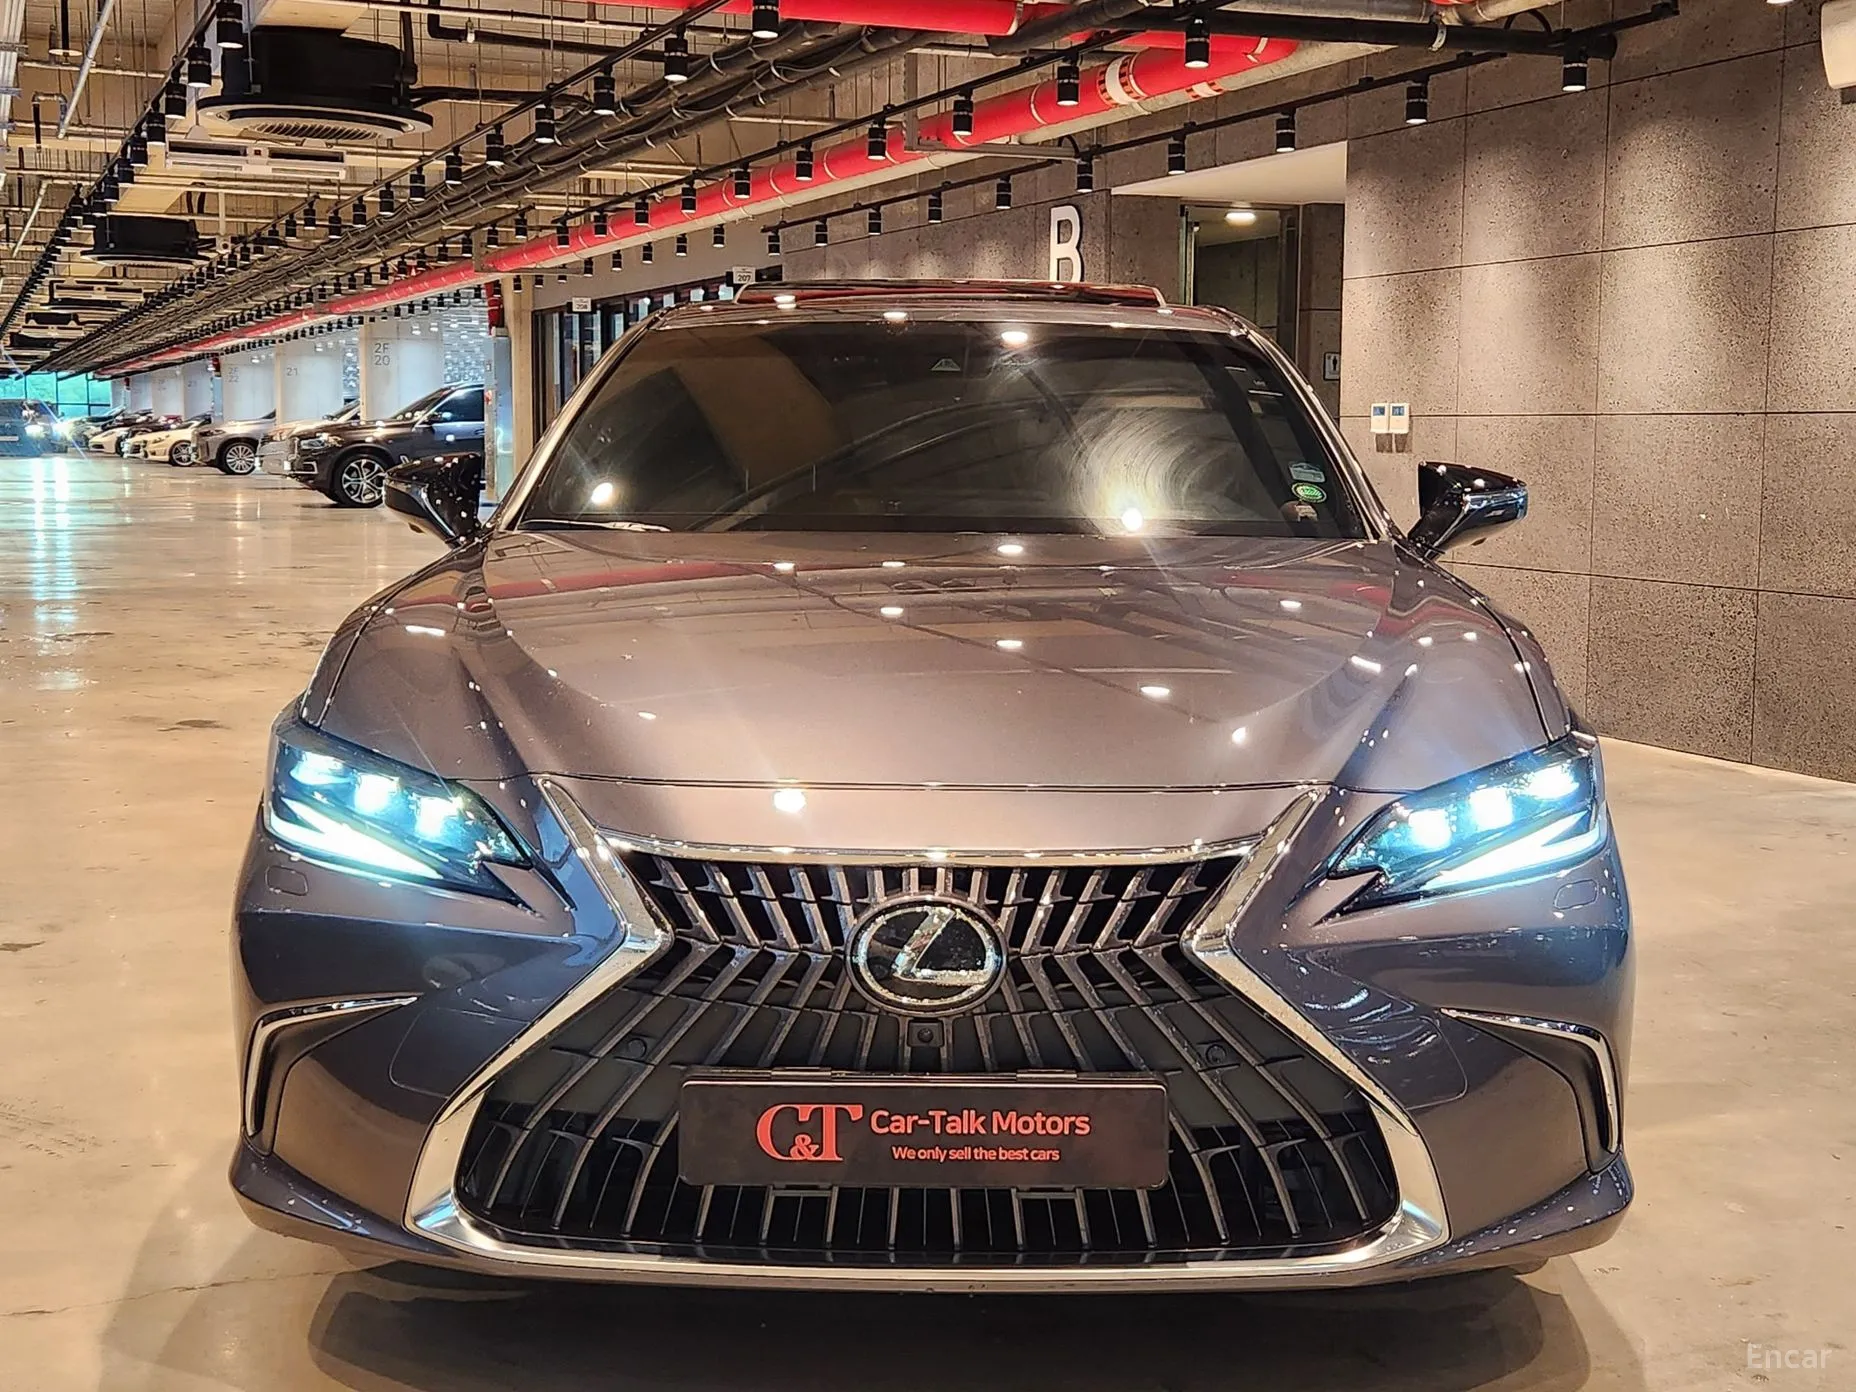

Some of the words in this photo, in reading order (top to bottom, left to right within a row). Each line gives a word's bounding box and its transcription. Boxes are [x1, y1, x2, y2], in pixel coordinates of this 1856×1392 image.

[1049, 205, 1082, 282] B
[374, 342, 390, 354] 2F
[374, 355, 391, 366] 20
[286, 367, 299, 377] 21
[870, 1109, 985, 1136] Car-Talk
[991, 1110, 1091, 1136] Motors
[892, 1146, 916, 1160] We
[917, 1146, 947, 1163] only
[948, 1147, 971, 1160] sell
[973, 1147, 997, 1160] the
[998, 1147, 1029, 1161] best
[1030, 1149, 1060, 1161] cars
